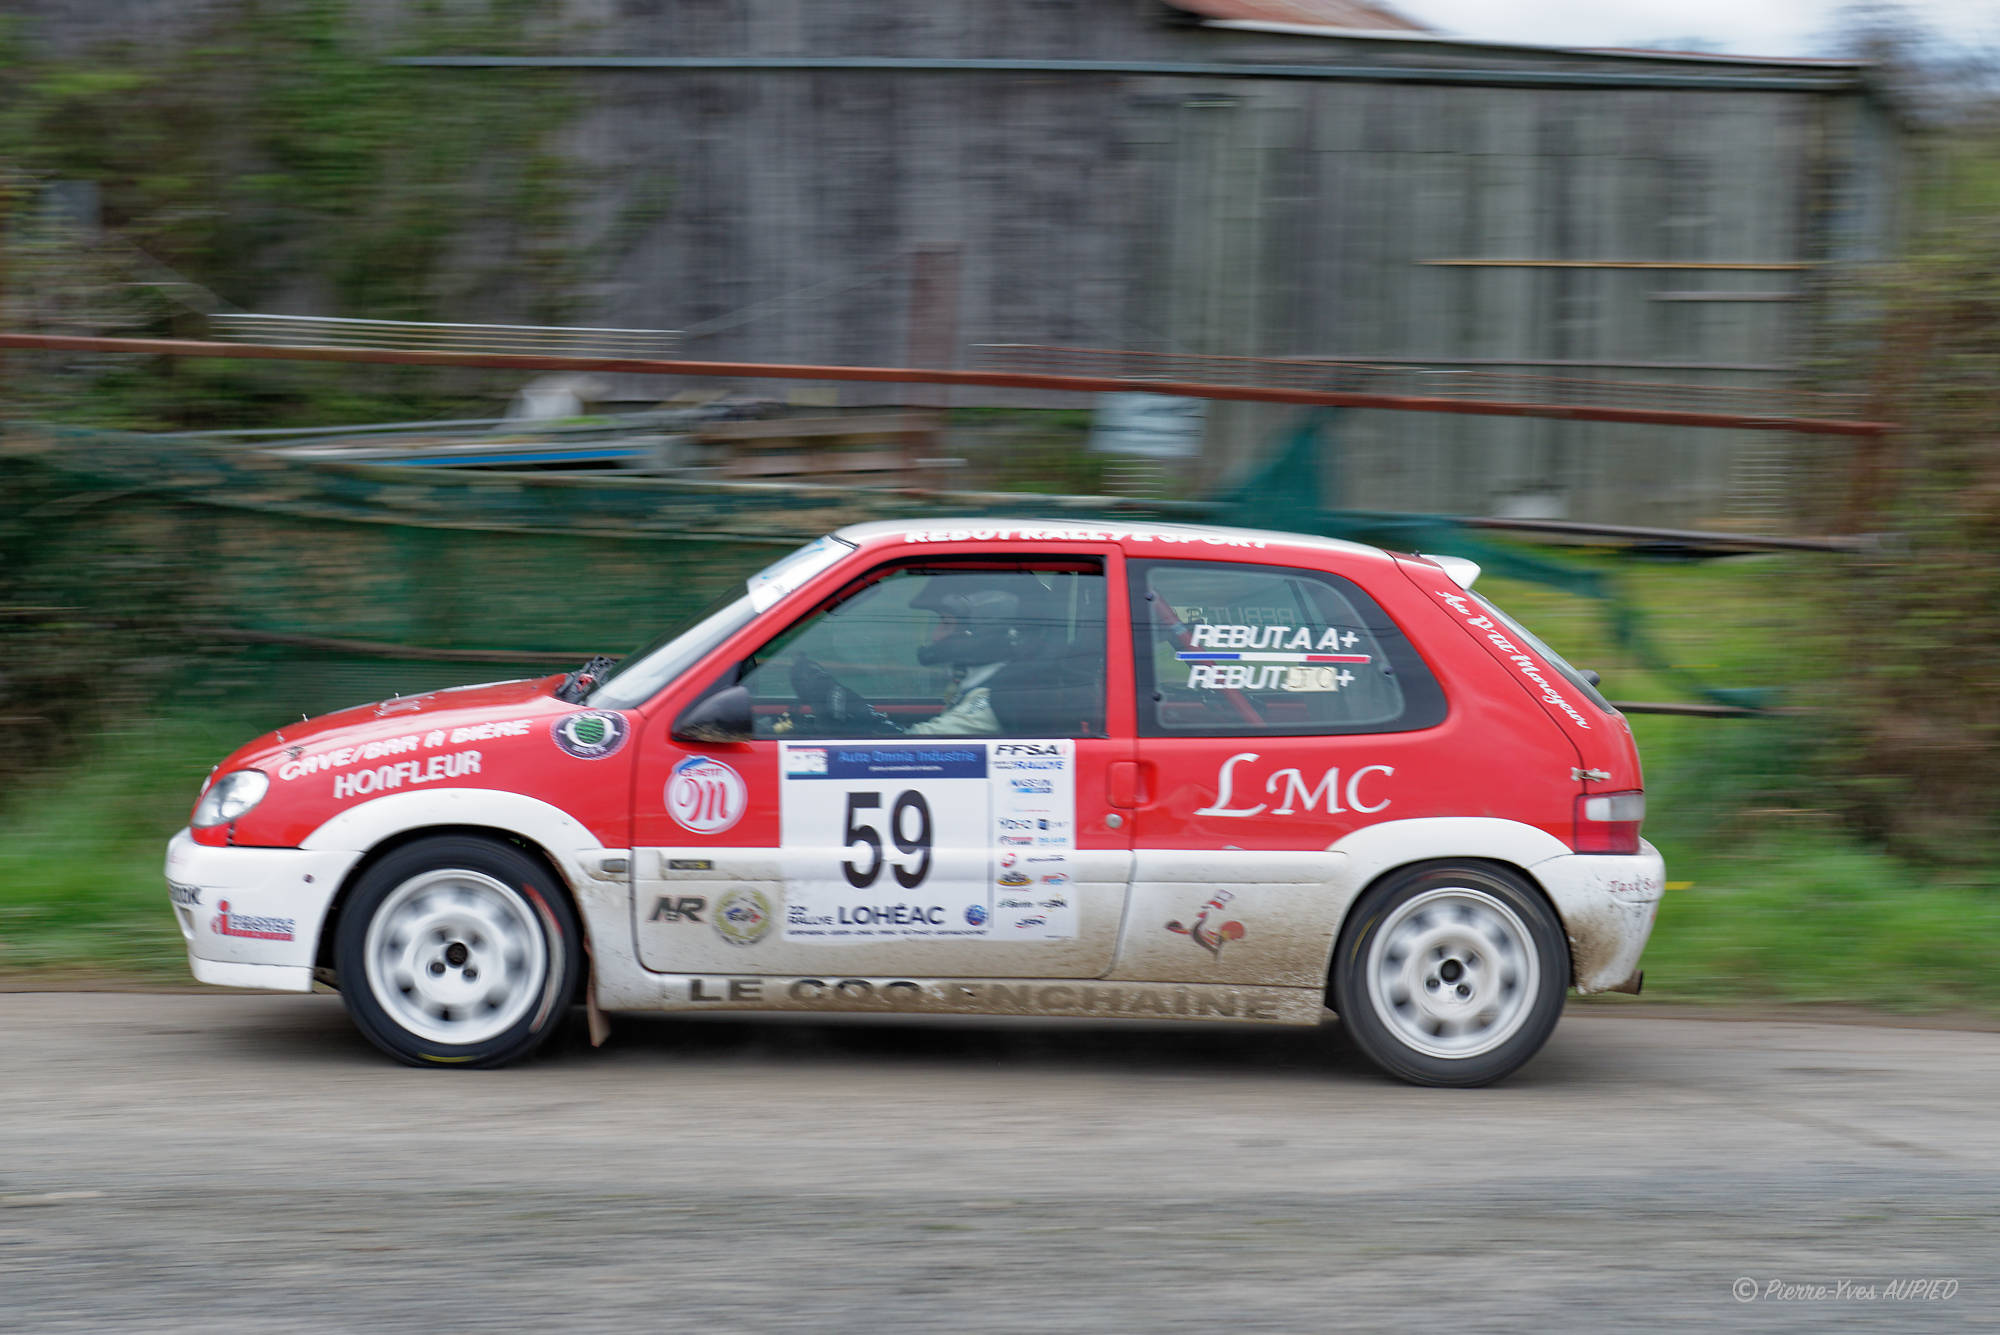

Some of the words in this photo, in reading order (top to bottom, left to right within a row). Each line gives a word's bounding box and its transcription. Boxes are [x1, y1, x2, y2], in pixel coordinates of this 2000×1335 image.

[1315, 627, 1360, 651] A+
[838, 750, 869, 763] Auto
[872, 750, 914, 763] Omnia
[917, 750, 977, 763] Industrie
[995, 744, 1059, 756] FFSA
[333, 749, 483, 799] HONFLEUR
[1193, 753, 1396, 817] LMC
[840, 788, 933, 890] 59
[838, 902, 946, 926] LOHÉAC
[690, 979, 764, 1001] LE
